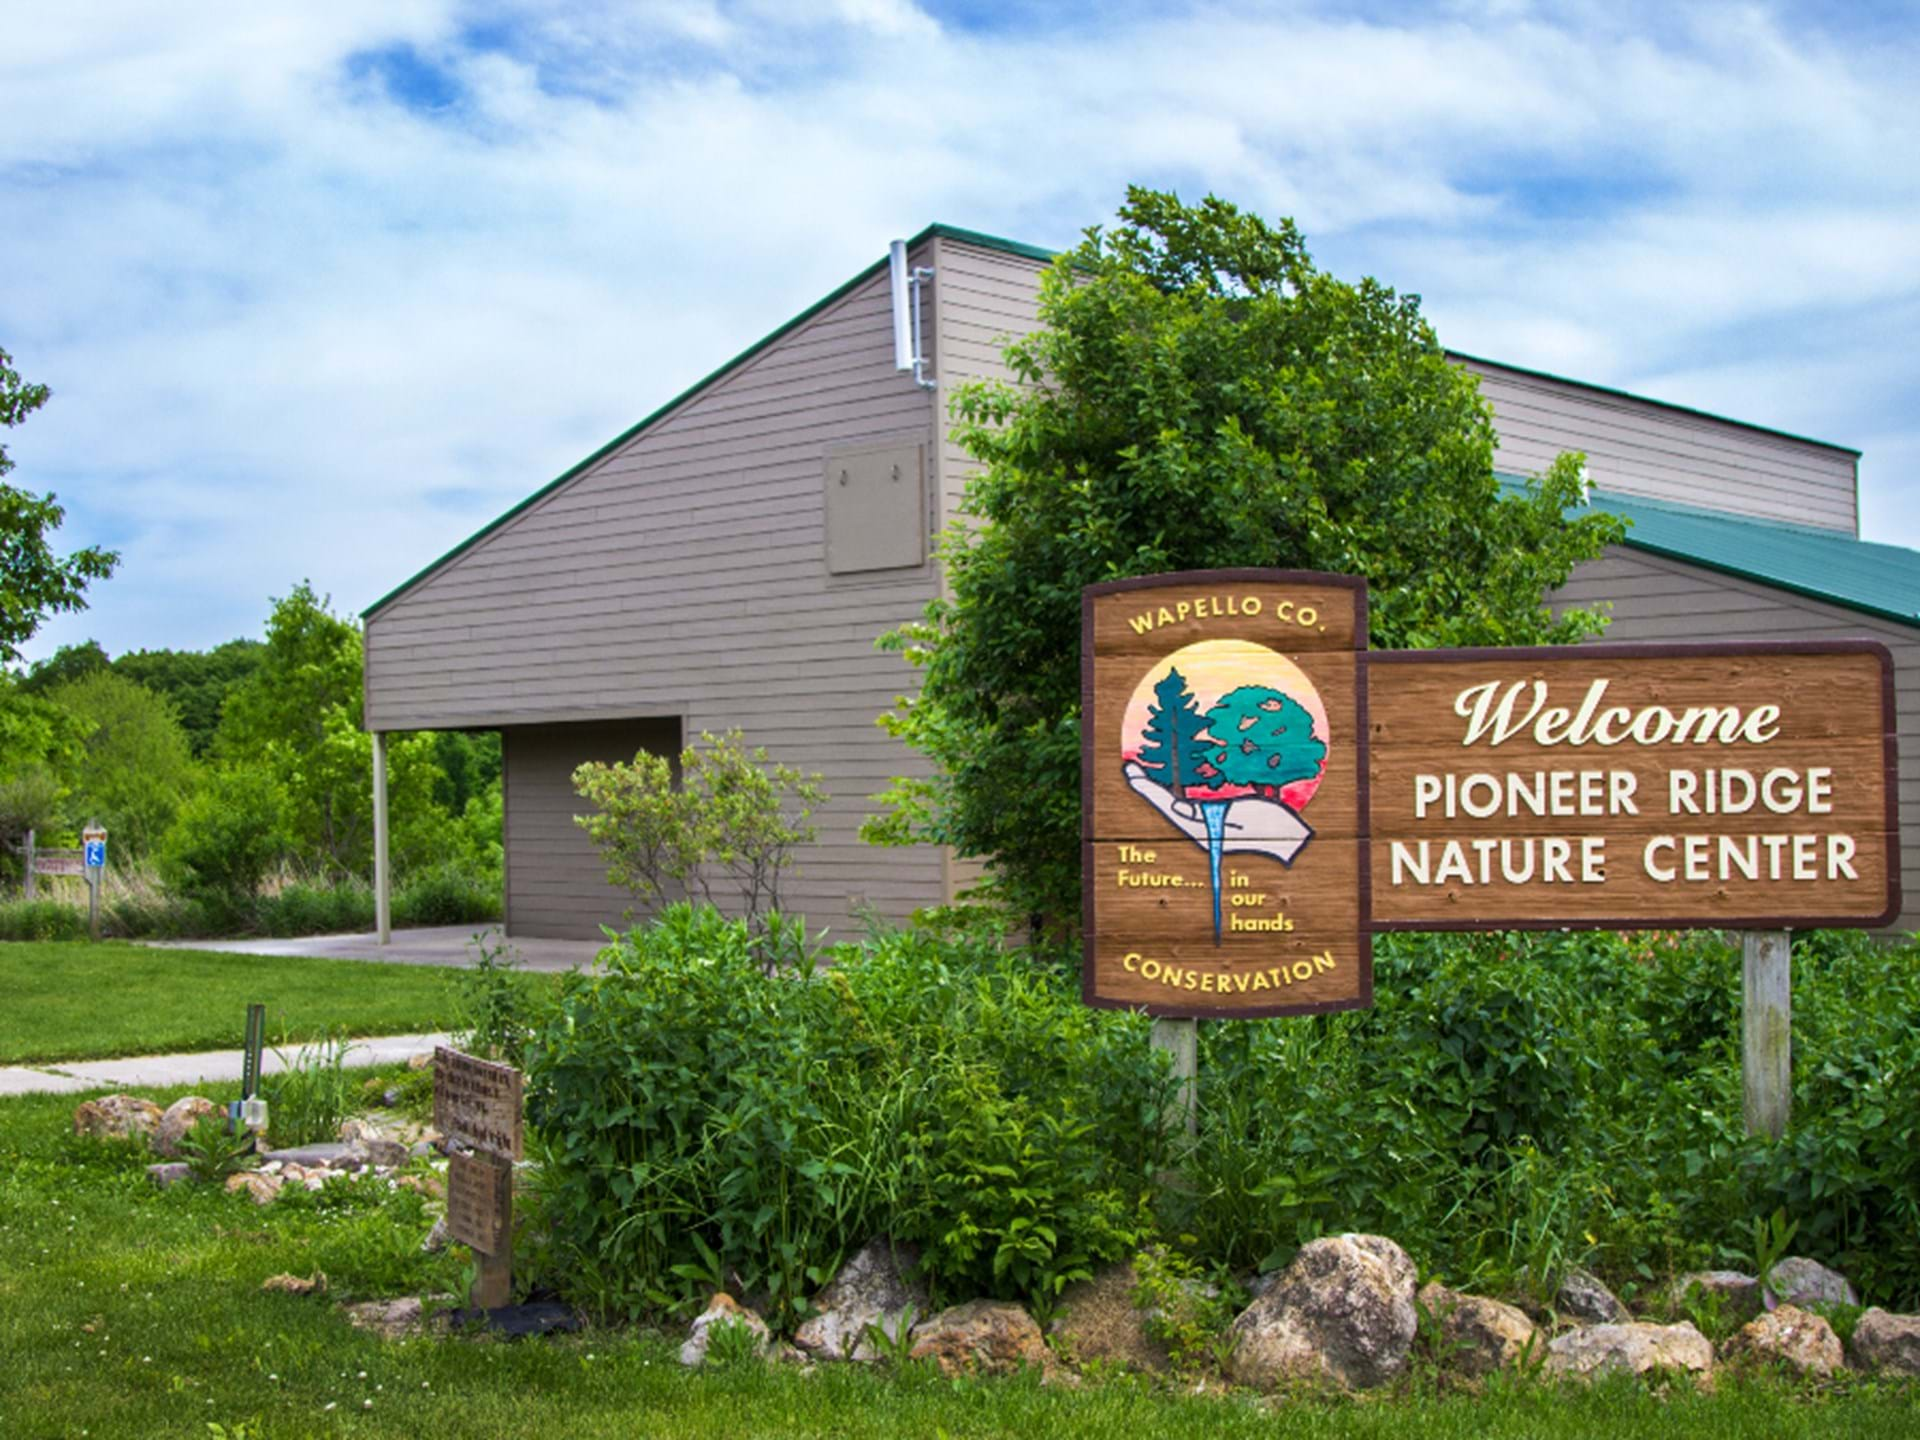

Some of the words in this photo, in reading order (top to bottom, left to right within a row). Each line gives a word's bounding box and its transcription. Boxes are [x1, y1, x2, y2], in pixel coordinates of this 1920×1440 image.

[1128, 596, 1263, 636] WAPELLO
[1276, 601, 1327, 633] CO.
[1454, 678, 1781, 746] Welcome
[1414, 769, 1639, 818] PIONEER
[1669, 767, 1833, 814] RIDGE
[1118, 845, 1157, 865] The
[1390, 837, 1606, 885] NATURE
[1643, 834, 1859, 882] CENTER
[1117, 871, 1204, 888] Future...
[1230, 869, 1249, 888] in
[1230, 892, 1266, 908] our
[1230, 914, 1294, 933] hands
[1122, 950, 1337, 995] CONSERVATION
